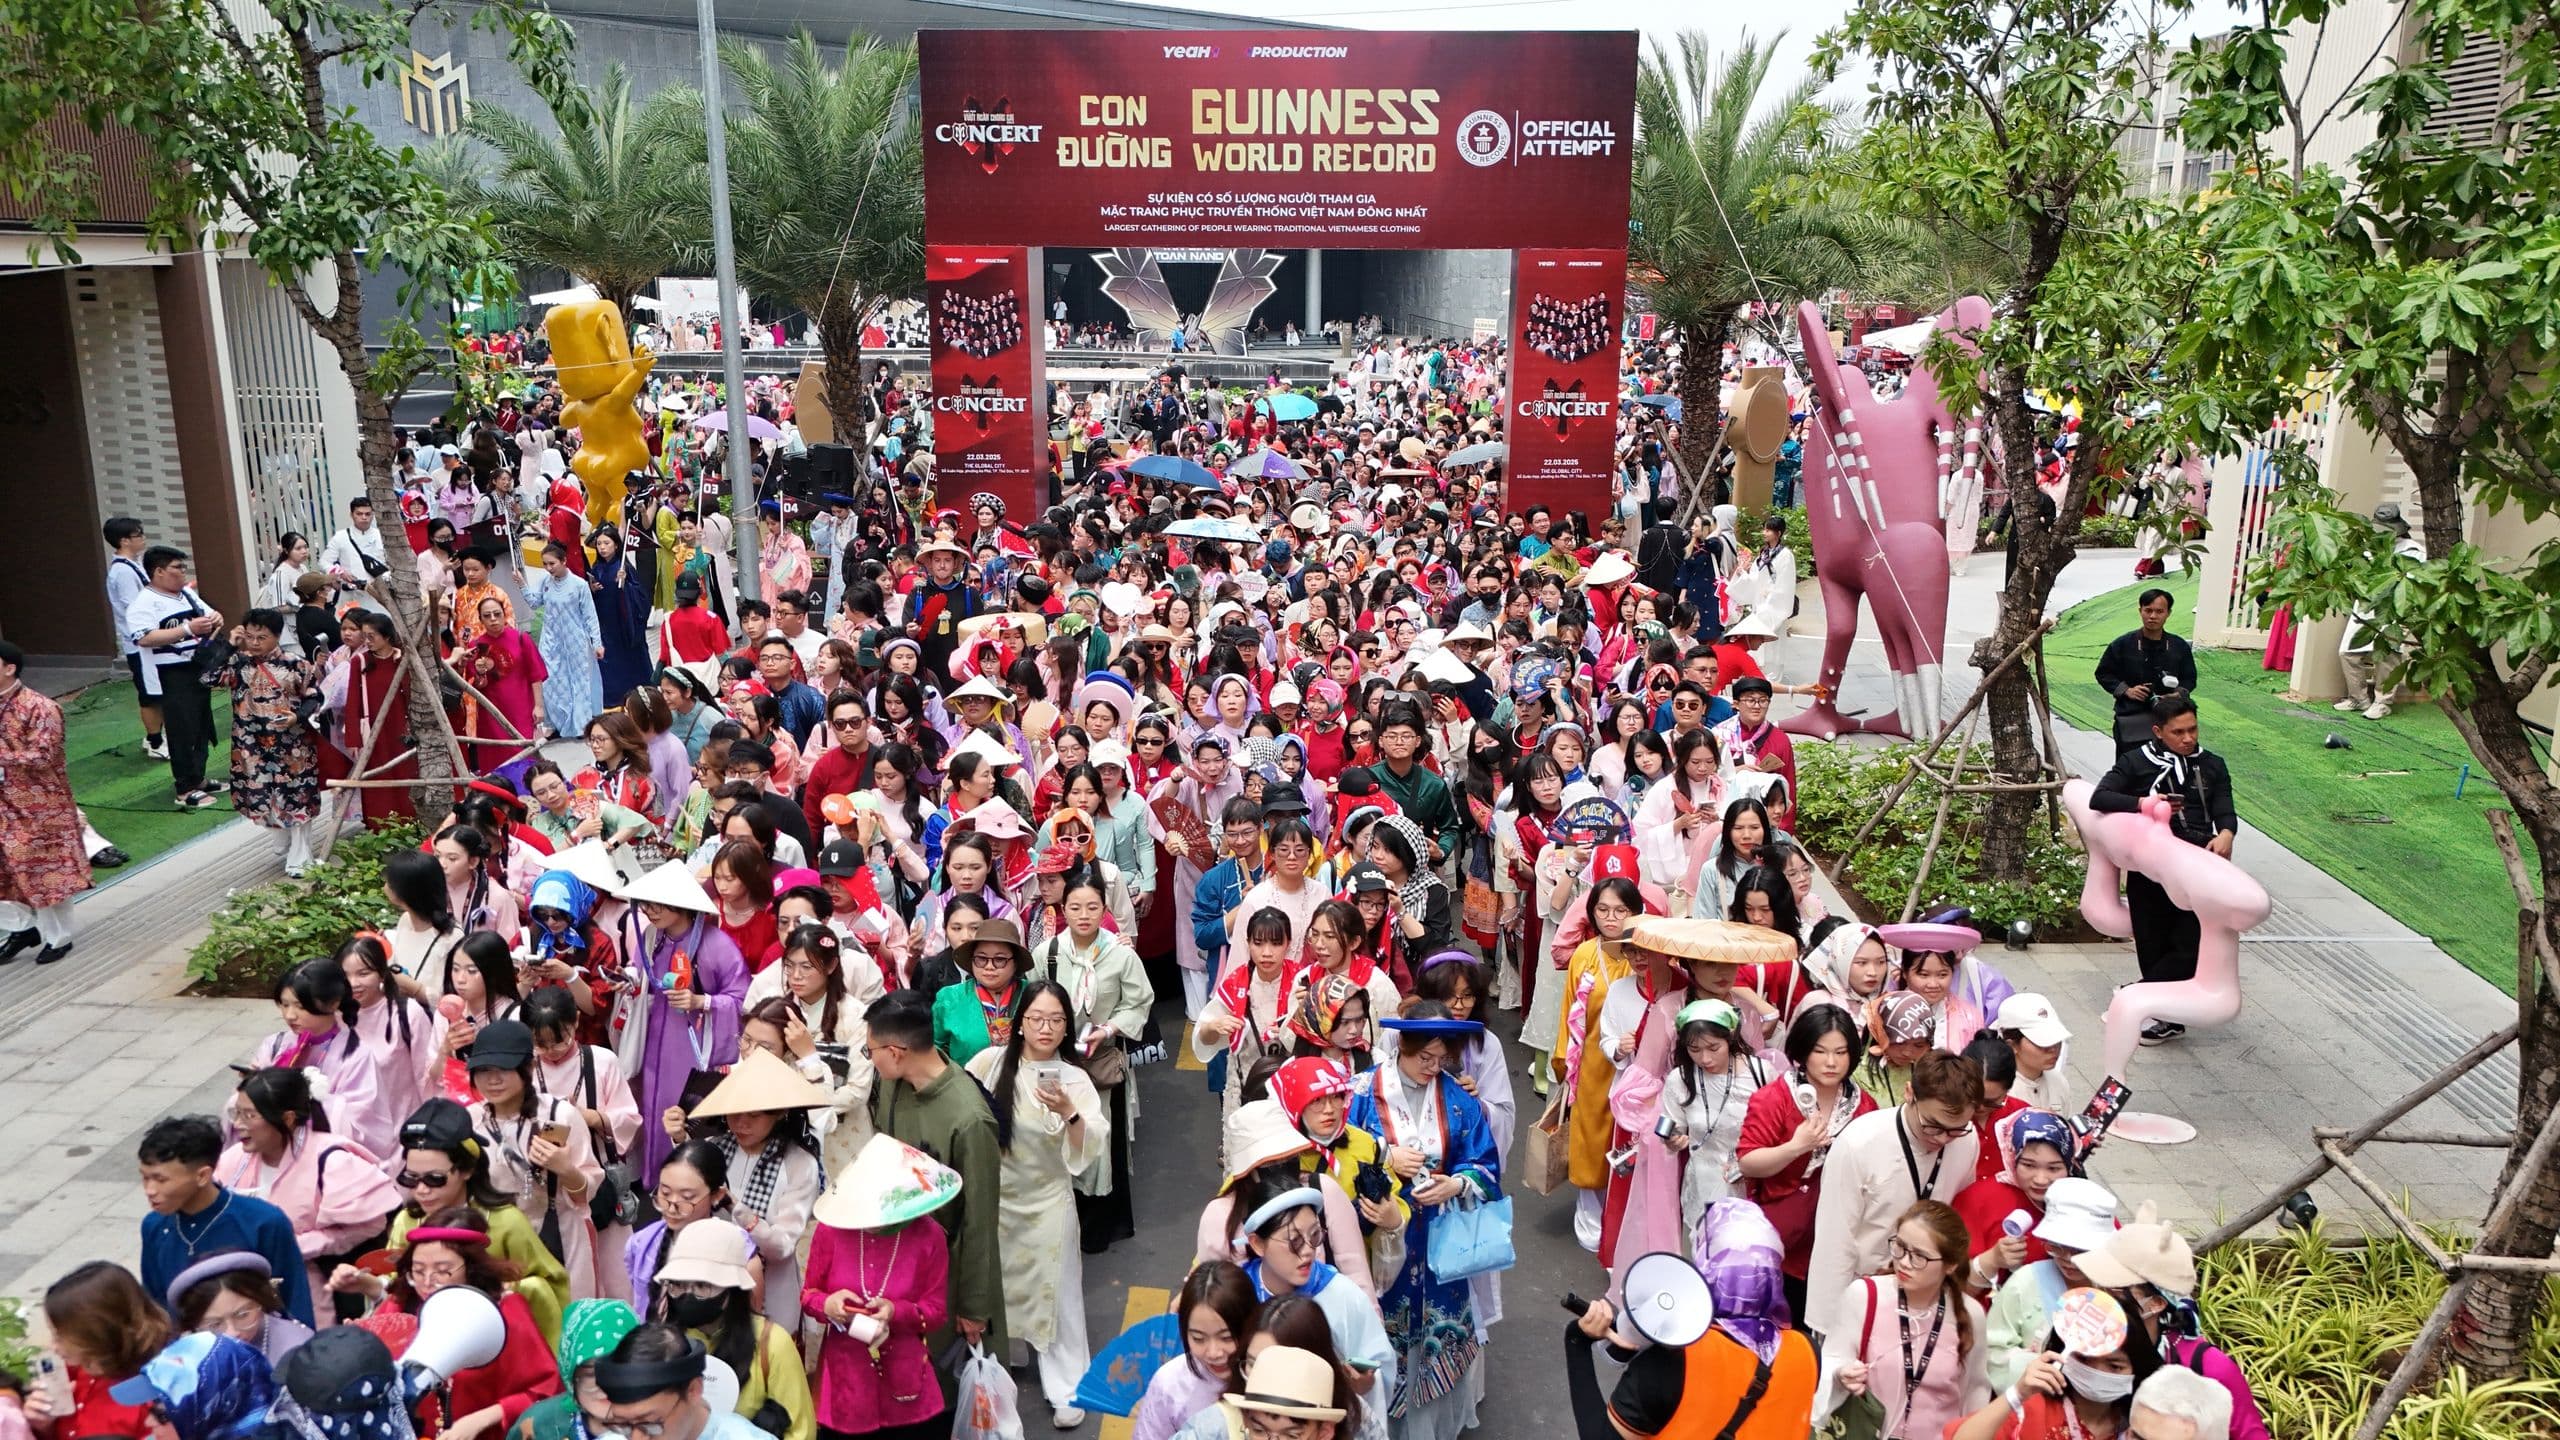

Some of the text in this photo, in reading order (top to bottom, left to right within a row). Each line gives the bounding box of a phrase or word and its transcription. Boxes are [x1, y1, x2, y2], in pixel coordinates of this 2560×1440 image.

[1251, 46, 1348, 58] PRODUCTION
[1080, 95, 1147, 126] CON
[1192, 88, 1440, 135] GUINNESS
[1465, 113, 1503, 129] GUINNESS
[1522, 121, 1615, 137] OFFICIAL
[1056, 131, 1172, 168] ĐƯỜNG
[1460, 134, 1507, 163] WORLD RECORDS
[1521, 140, 1615, 156] ATTEMPT
[1193, 142, 1436, 172] WORLD RECORD
[1147, 191, 1376, 206] SỰ KIỆN CÓ SỐ LƯỢNG NGƯỜI THAM GIA
[1100, 204, 1127, 218] MẶC
[1129, 206, 1169, 217] TRANG
[1171, 206, 1205, 218] PHỤC
[1255, 204, 1297, 217] THỐNG
[1299, 206, 1325, 219] VIỆT
[1327, 207, 1354, 217] NAM
[1395, 205, 1428, 217] NHẤT
[1104, 224, 1420, 233] LARGEST GATHERING OF PEOPLE WEARING TRADITIONAL VIETNAMESE CLOTHING
[703, 483, 719, 495] 03
[783, 502, 799, 514] 04
[627, 535, 640, 547] 02
